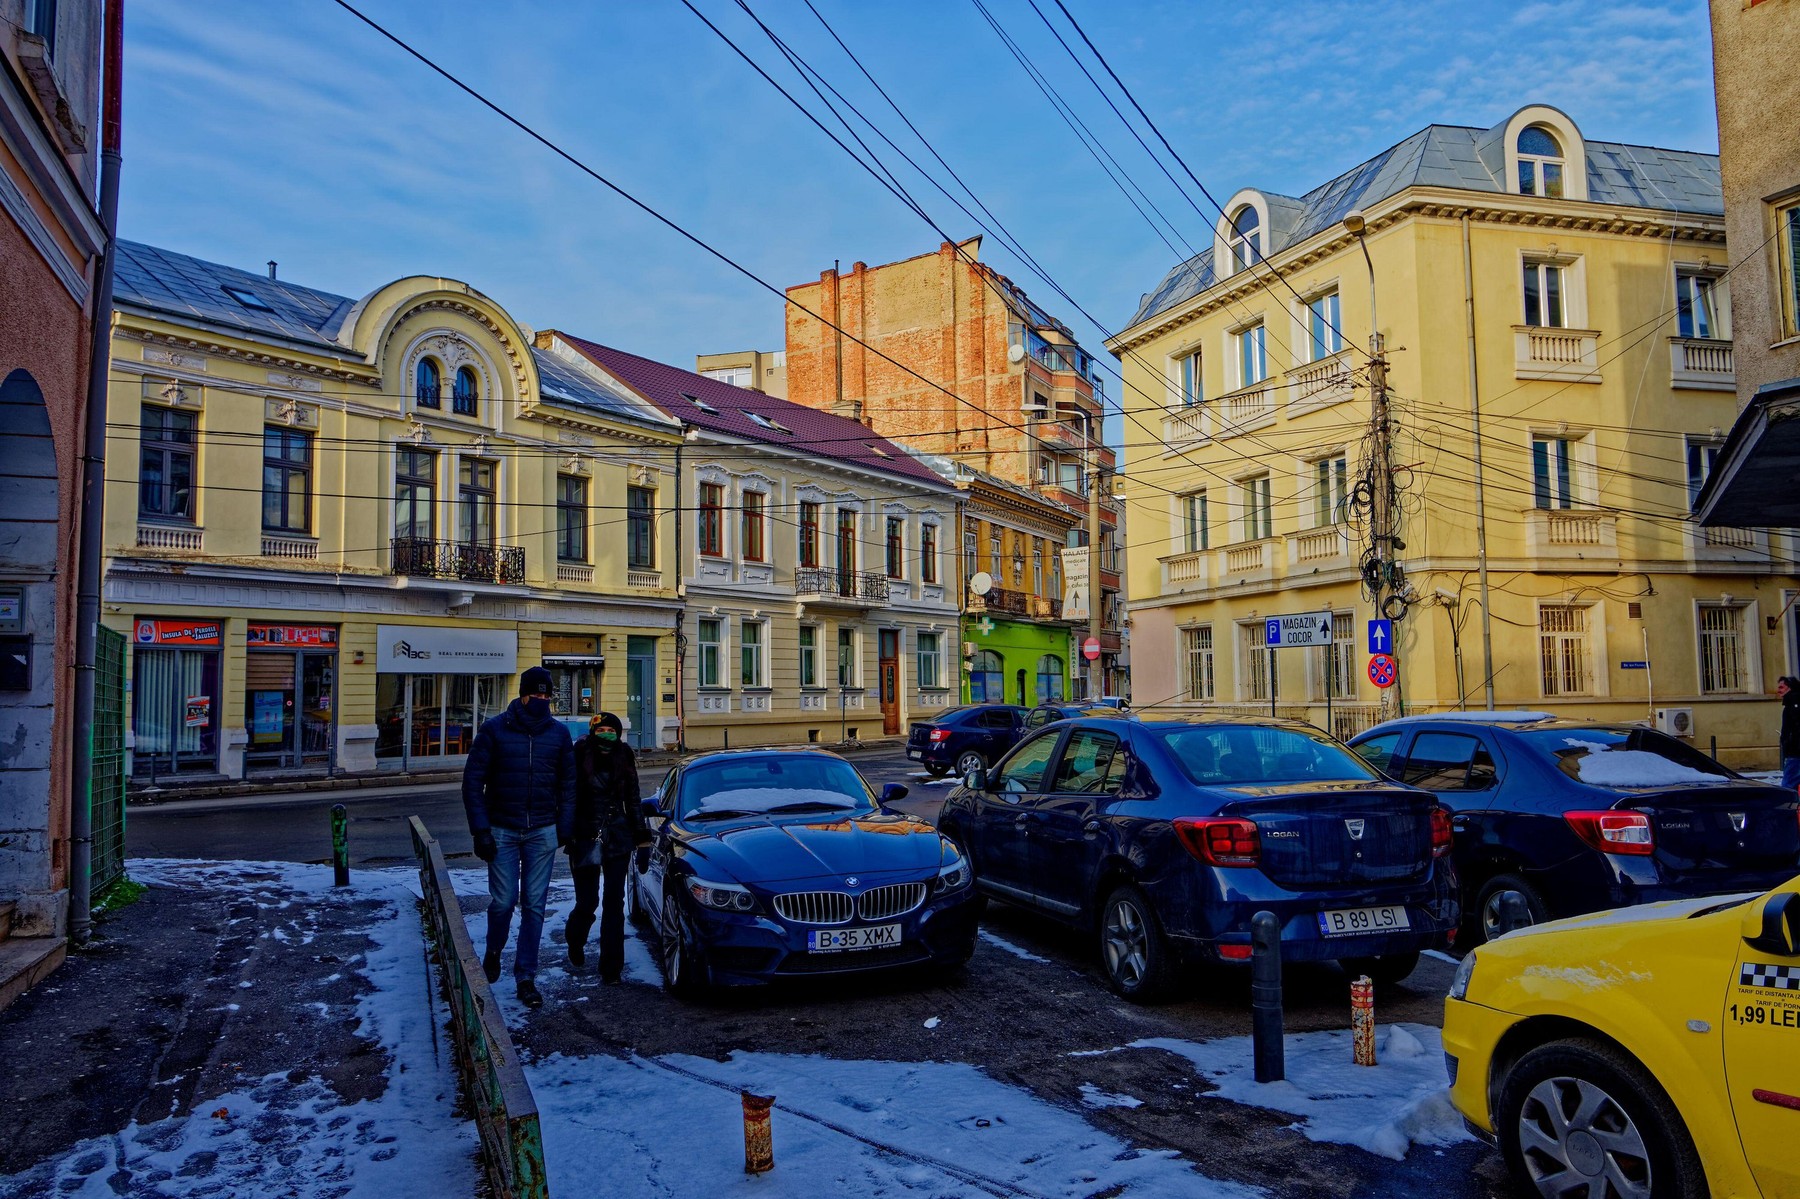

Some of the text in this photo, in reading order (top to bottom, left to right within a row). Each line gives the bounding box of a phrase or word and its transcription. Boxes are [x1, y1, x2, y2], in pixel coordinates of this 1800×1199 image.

[1066, 607, 1086, 617] 20 m
[1282, 617, 1317, 630] MAGAZIN
[1287, 631, 1312, 643] COCOR
[1321, 908, 1398, 932] RO B 89 LSI
[820, 932, 832, 948] B
[839, 930, 858, 946] 35
[863, 926, 895, 945] XMX
[1765, 991, 1794, 999] DISTANTA
[1730, 1004, 1765, 1025] 1,99
